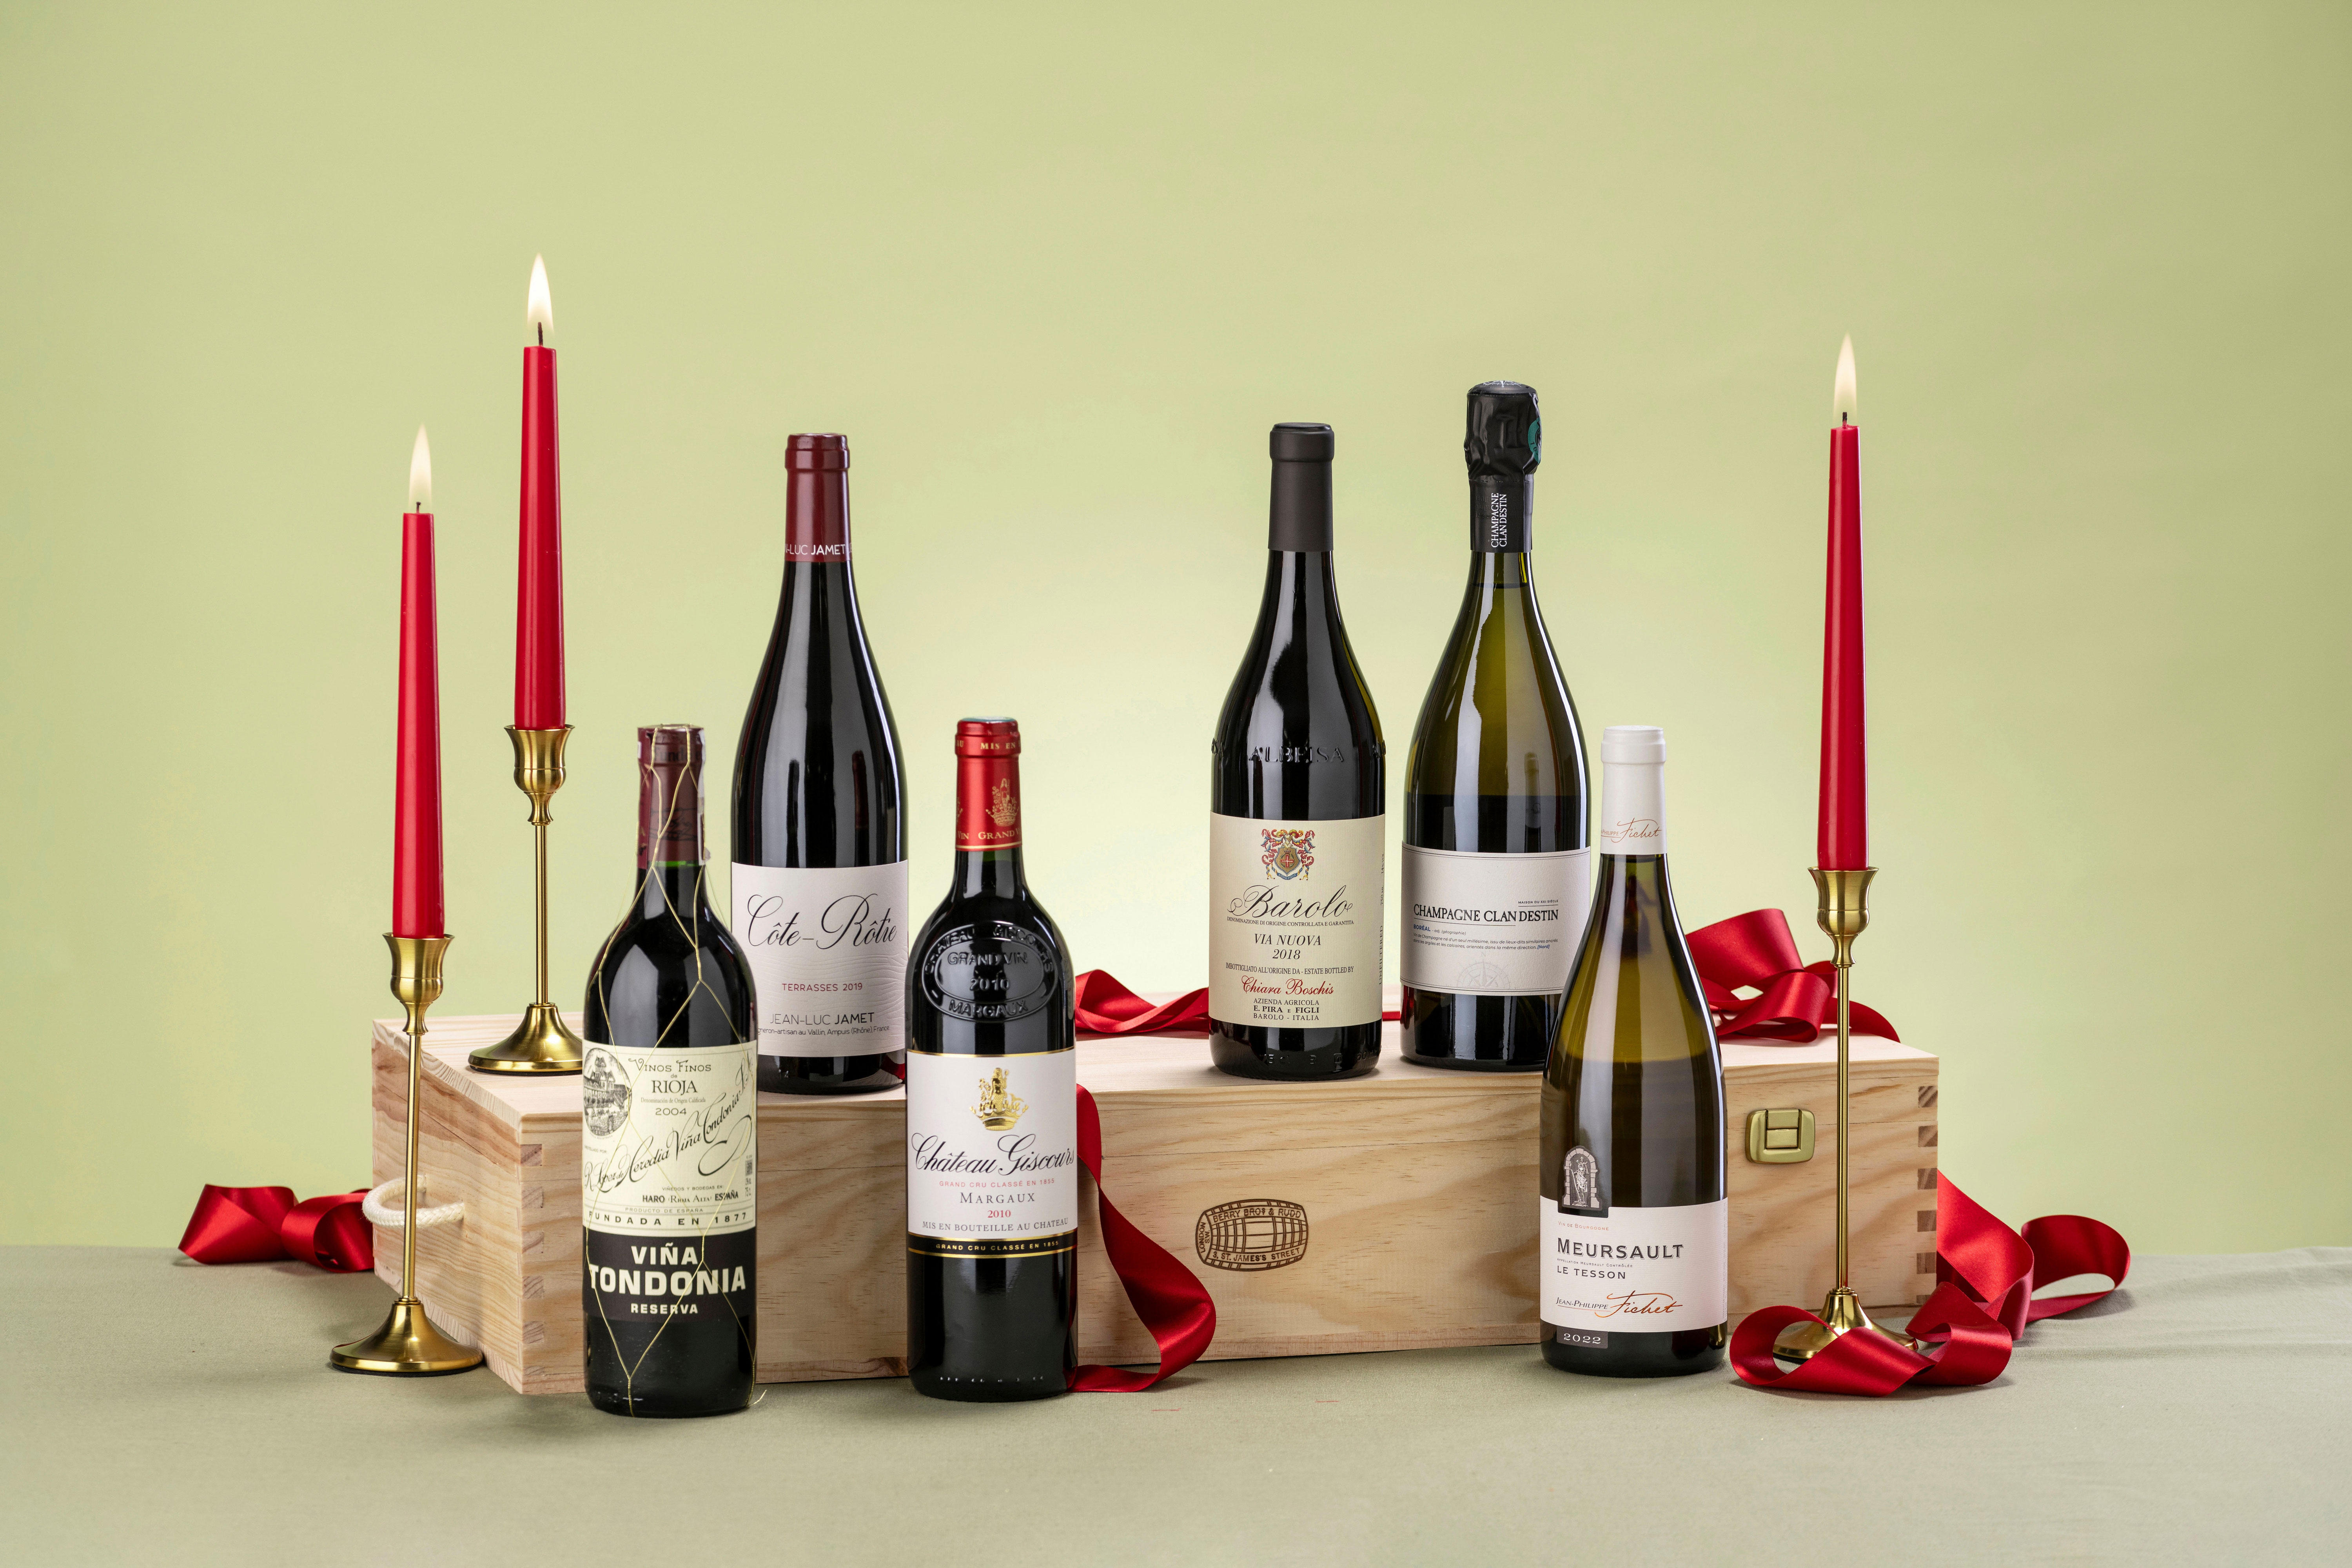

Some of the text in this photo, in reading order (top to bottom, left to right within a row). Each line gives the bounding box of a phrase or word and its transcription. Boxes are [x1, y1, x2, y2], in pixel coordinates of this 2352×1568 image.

[1491, 493, 1499, 548] CHAMPAGNE
[811, 544, 846, 555] JAMET
[1249, 746, 1345, 763] ALBEISA
[978, 830, 1015, 840] GRAND
[1611, 818, 1662, 843] Fichet
[1227, 885, 1353, 918] Barolo
[1414, 904, 1480, 921] CHAMPAGNE
[1227, 916, 1259, 924] DENOMINAZIONE
[1254, 934, 1321, 946] VIA NUOVA
[947, 952, 1028, 965] GRAND VIN
[1272, 949, 1301, 960] 2018
[1226, 963, 1257, 972] IMBOTTIGLIATO
[782, 983, 862, 992] TERRASSES 2019
[969, 978, 1010, 991] 2010
[1241, 975, 1334, 995] Chiara Boschis
[948, 999, 1028, 1018] MARGAUX
[770, 1012, 875, 1025] JEAN-LUC JAMET
[652, 1080, 698, 1096] RIOJA
[619, 1135, 670, 1187] Heredia
[666, 1111, 702, 1161] Viña
[911, 1133, 1075, 1176] Château Giscours
[715, 1190, 739, 1201] ESPAÑA
[960, 1192, 1035, 1204] MARGAUX
[589, 1211, 661, 1225] FUNDADA
[715, 1212, 746, 1224] 1877
[987, 1209, 1011, 1218] 2010
[1213, 1209, 1240, 1223] BERRY
[1278, 1208, 1301, 1218] RUDD
[922, 1221, 936, 1229] MIS
[1034, 1218, 1068, 1229] CHATEAU
[991, 1242, 1025, 1251] CLASSÉ
[1557, 1237, 1684, 1260] MEURSAULT
[631, 1242, 698, 1265] VIÑA
[1271, 1247, 1301, 1260] STREET
[1557, 1265, 1626, 1279] LE TESSON
[589, 1263, 746, 1296] TONDONIA
[631, 1303, 698, 1314] RESERVA
[1556, 1290, 1683, 1318] JEAN-PHILIPPE Fichet
[1563, 1332, 1602, 1345] 2022
